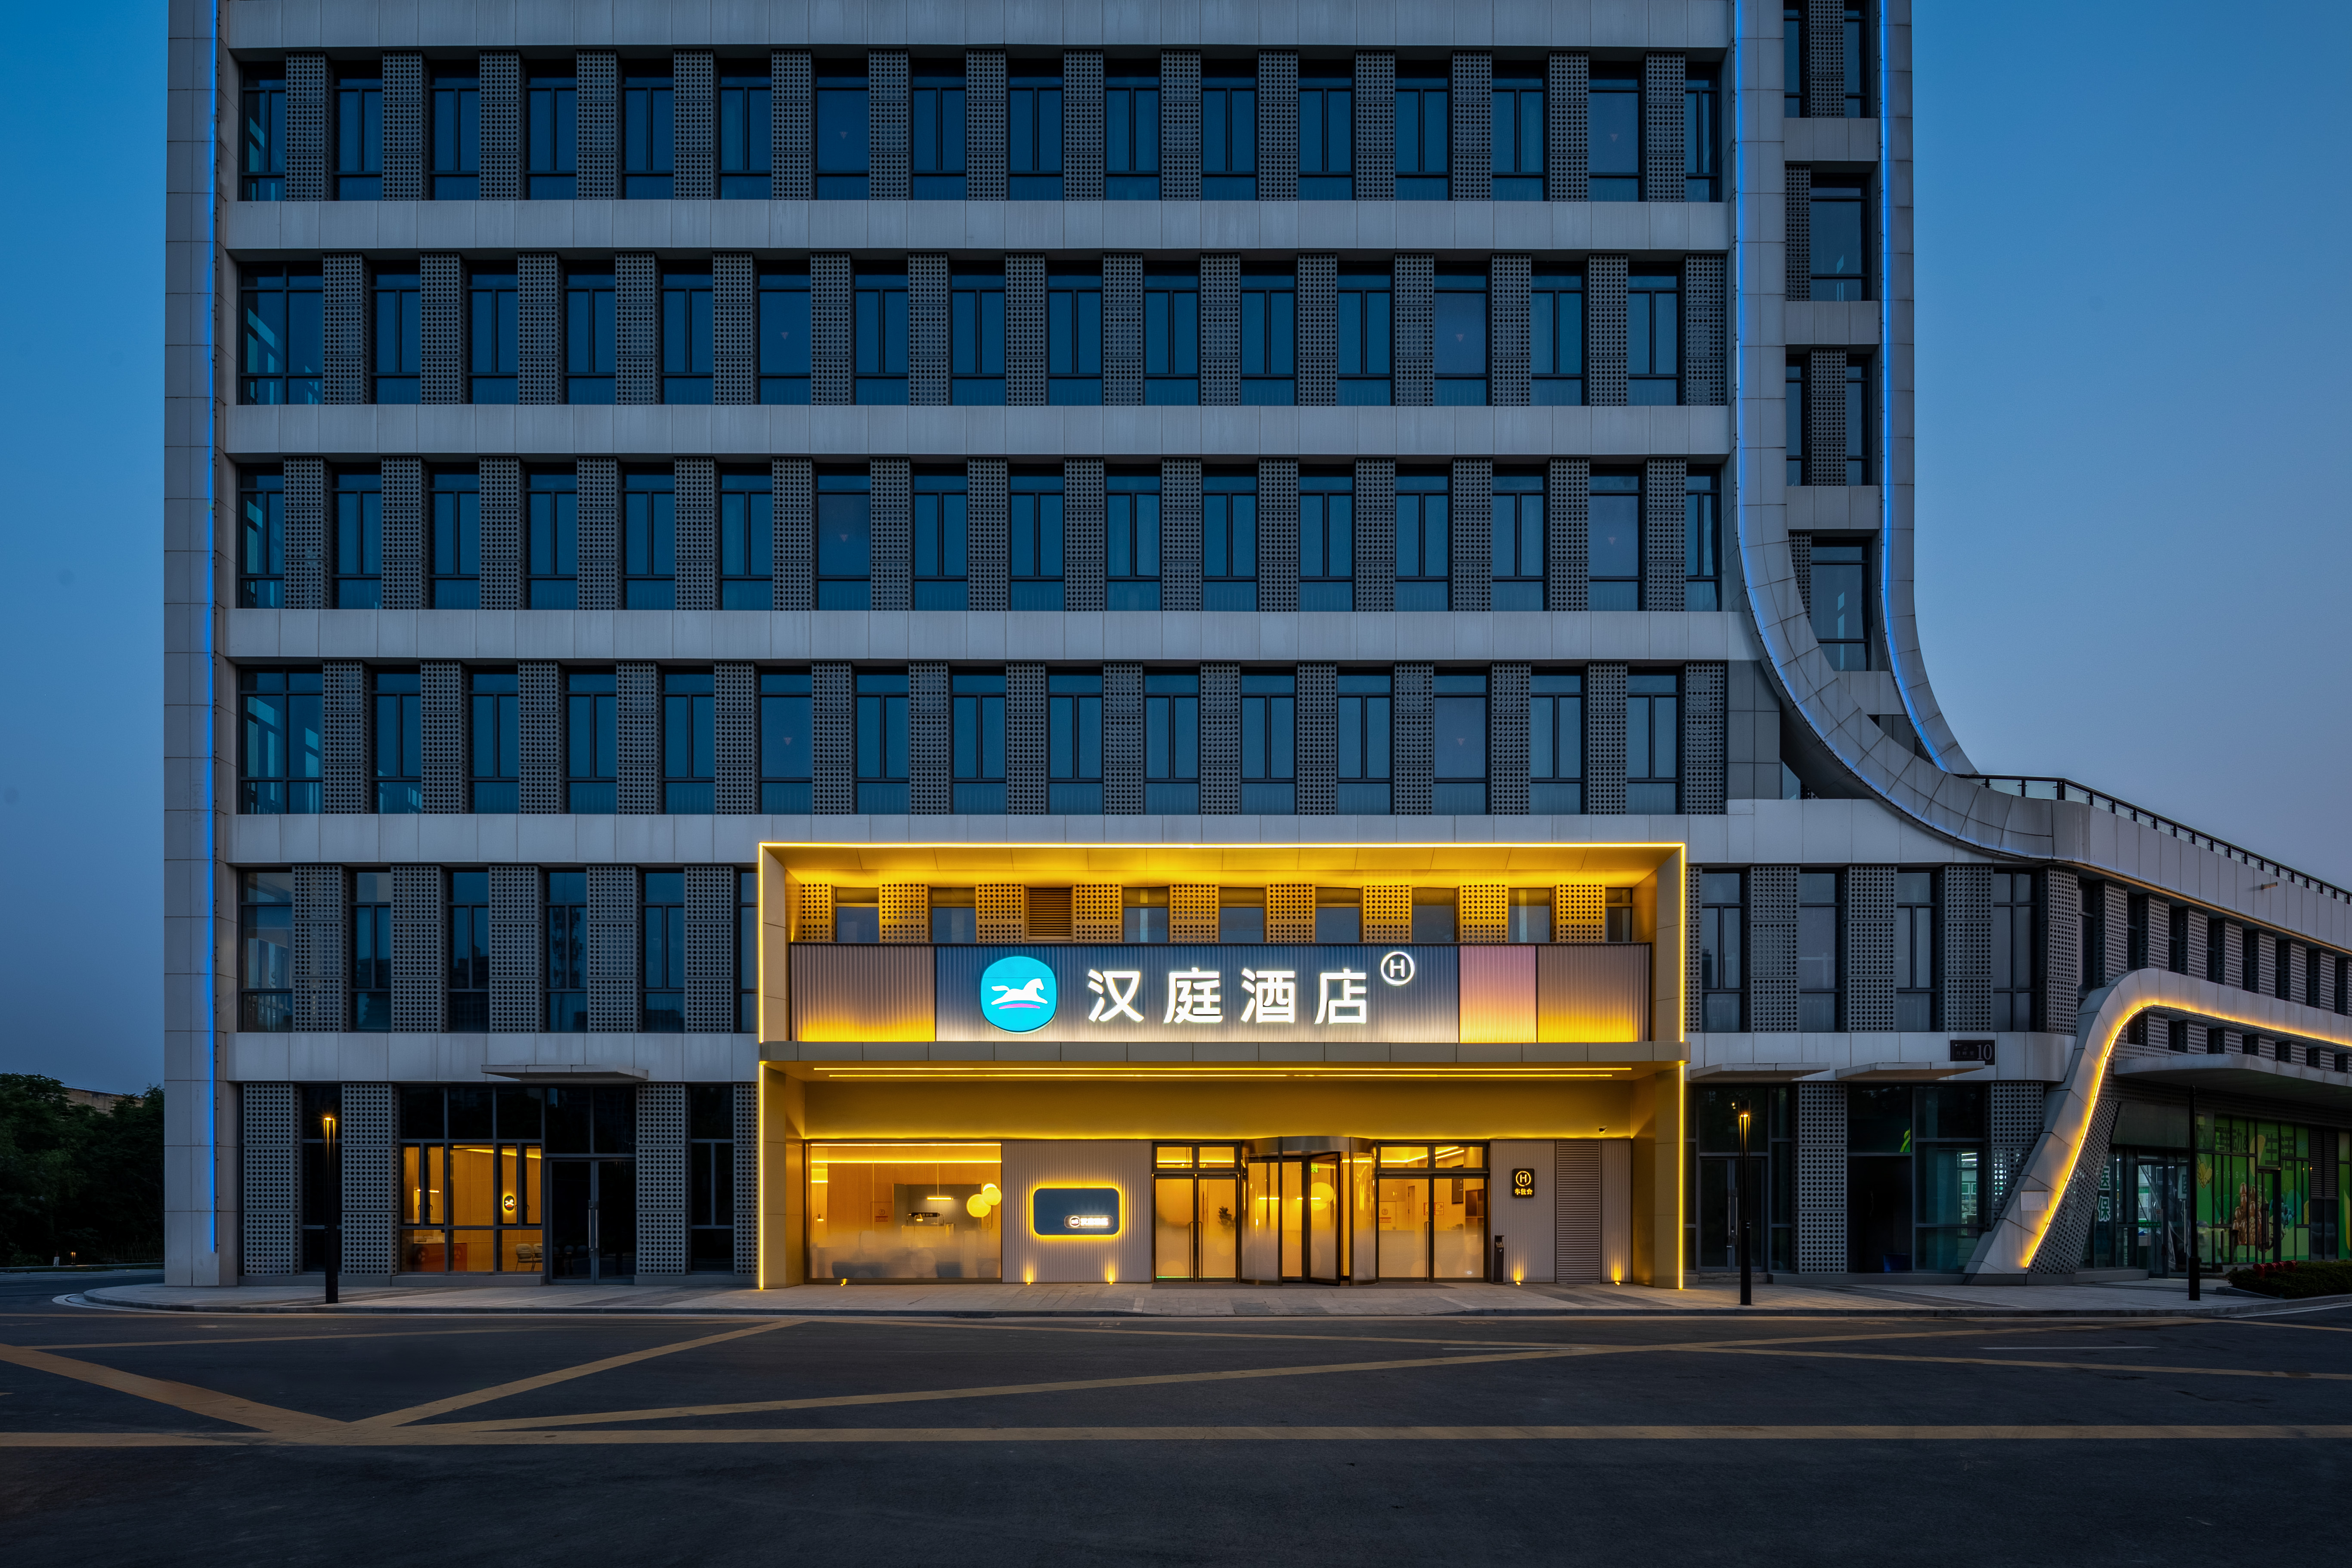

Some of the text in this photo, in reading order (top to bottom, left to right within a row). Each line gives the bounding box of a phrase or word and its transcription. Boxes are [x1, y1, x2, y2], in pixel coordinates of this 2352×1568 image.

[1088, 967, 1367, 1025] 汉庭酒店
[1977, 1044, 1993, 1060] 10
[2098, 1166, 2110, 1222] 医保
